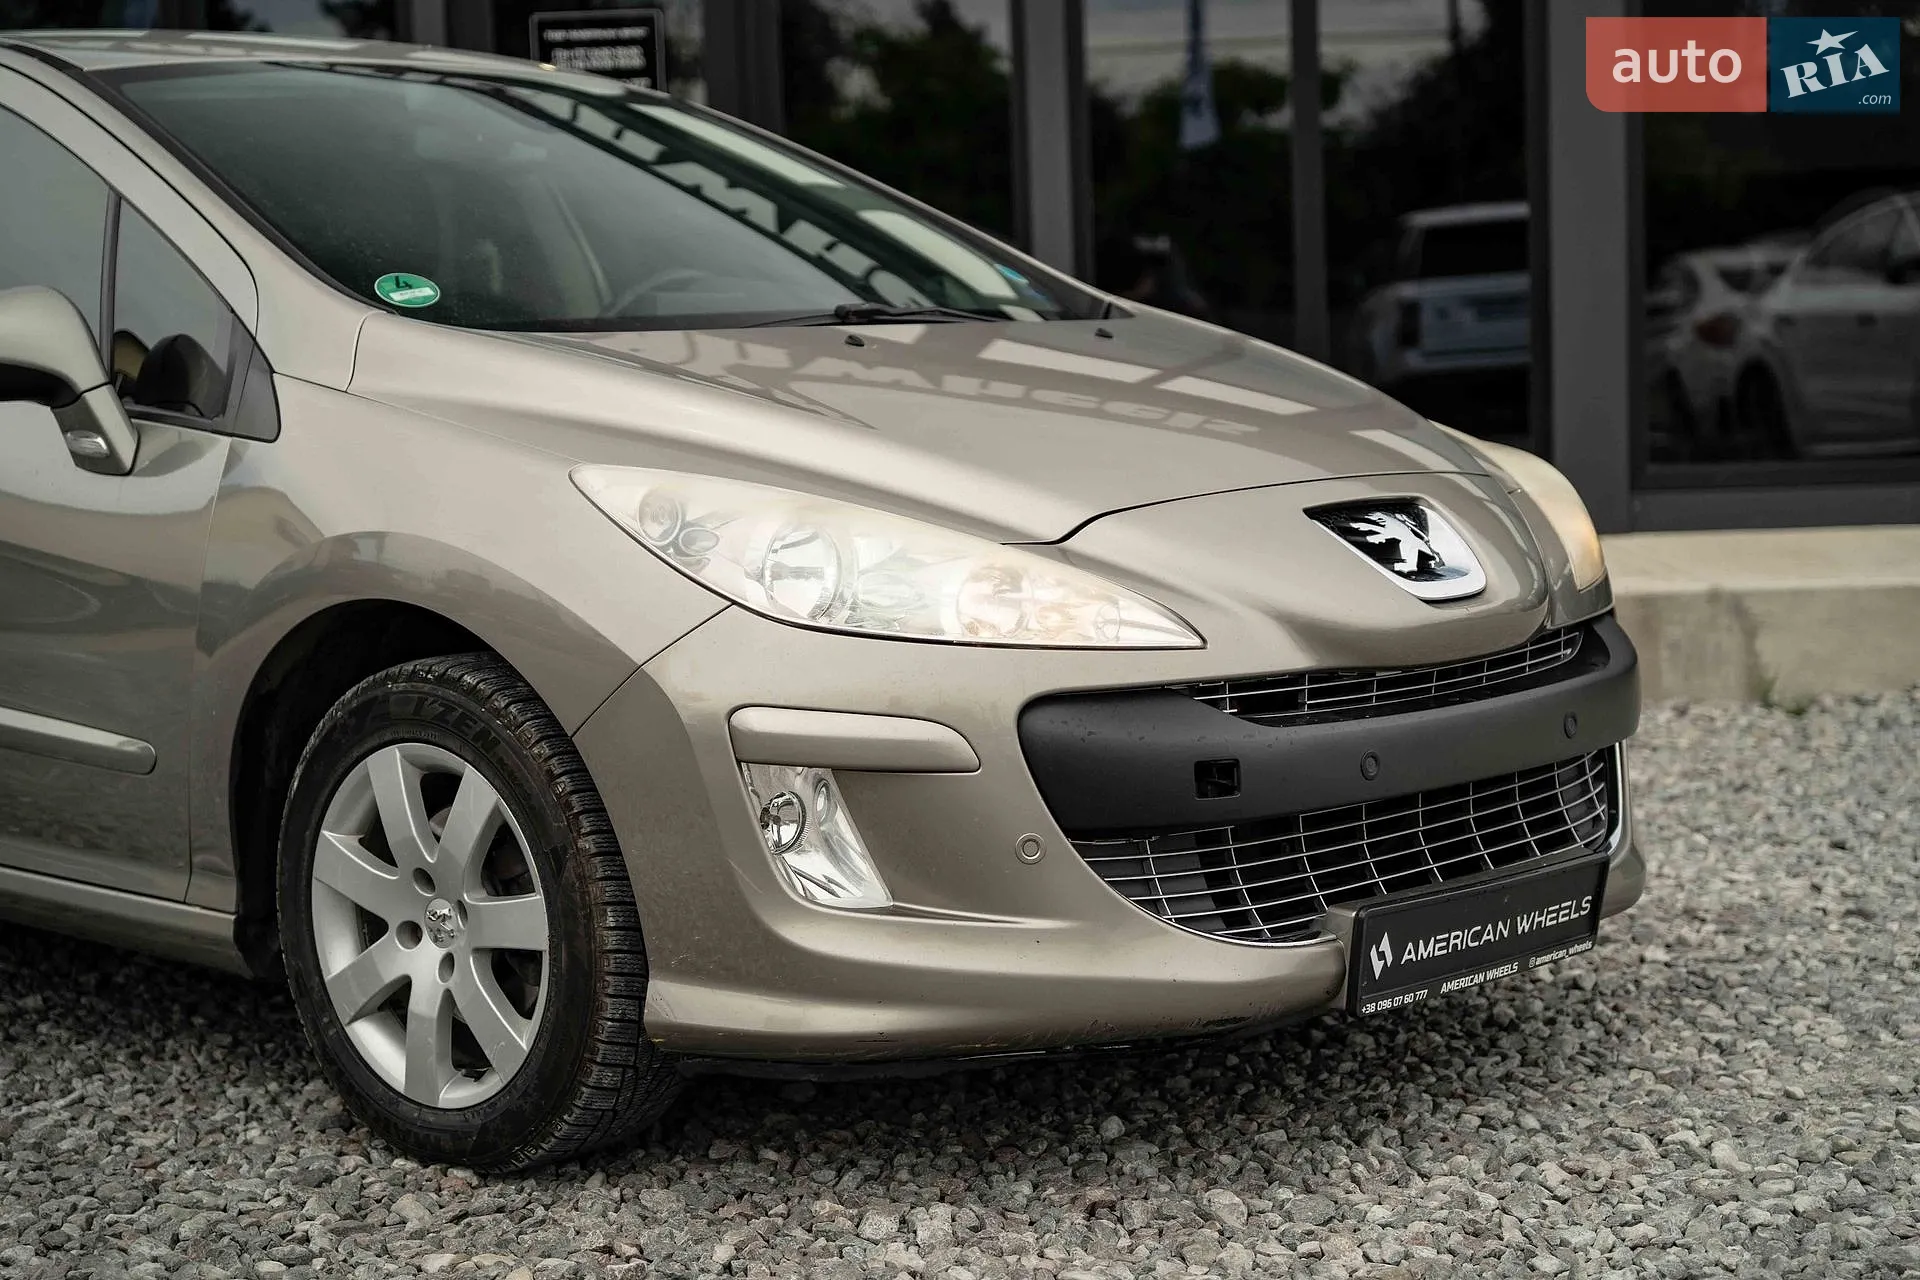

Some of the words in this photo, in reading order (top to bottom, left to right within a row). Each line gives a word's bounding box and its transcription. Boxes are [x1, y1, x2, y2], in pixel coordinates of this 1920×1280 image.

[1401, 918, 1511, 965] AMERICAN
[1516, 895, 1592, 936] WHEELS
[1440, 971, 1485, 994] AMERICAN
[1485, 961, 1519, 982] WHEELS
[1361, 1002, 1376, 1014] +38
[1377, 998, 1393, 1011] 096
[1393, 996, 1404, 1007] 07
[1404, 993, 1414, 1004] 60
